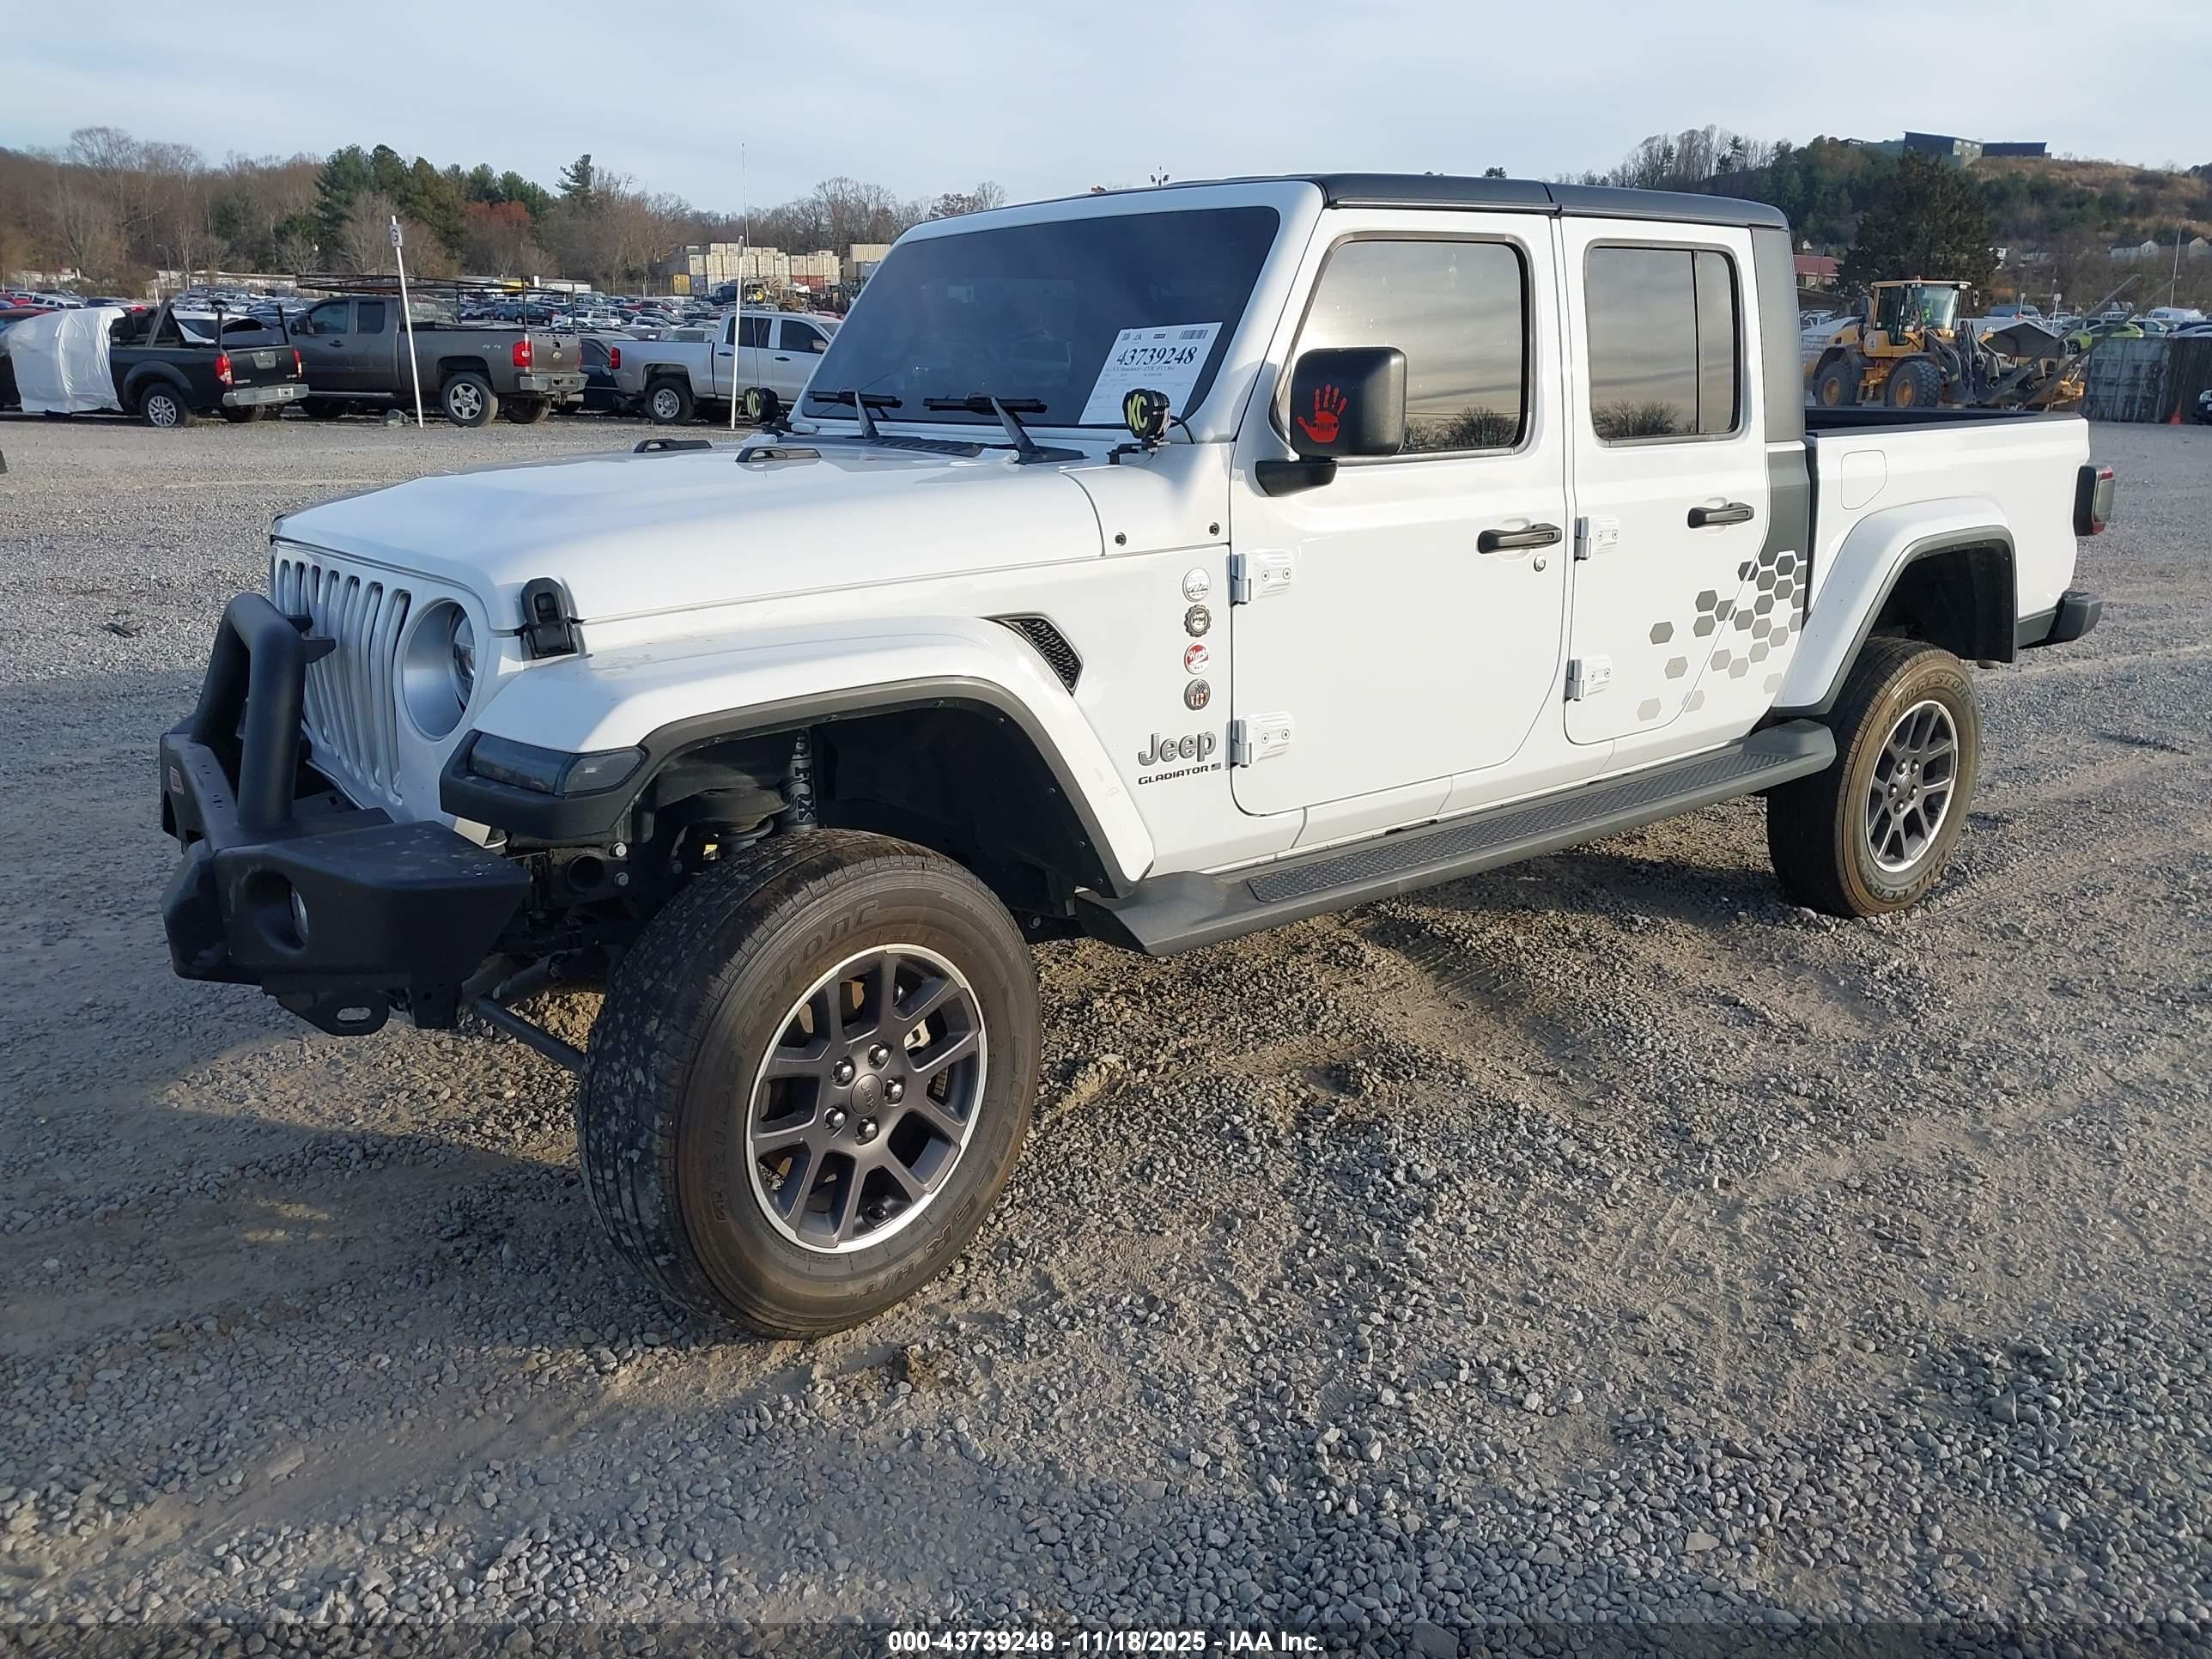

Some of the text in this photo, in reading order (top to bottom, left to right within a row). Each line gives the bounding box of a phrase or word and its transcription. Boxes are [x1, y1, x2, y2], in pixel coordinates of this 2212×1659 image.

[1116, 346, 1198, 366] 43739248
[746, 390, 761, 418] KC
[1127, 393, 1148, 431] KC
[1138, 732, 1217, 766] Jeep
[1138, 765, 1209, 785] GLADIATOR
